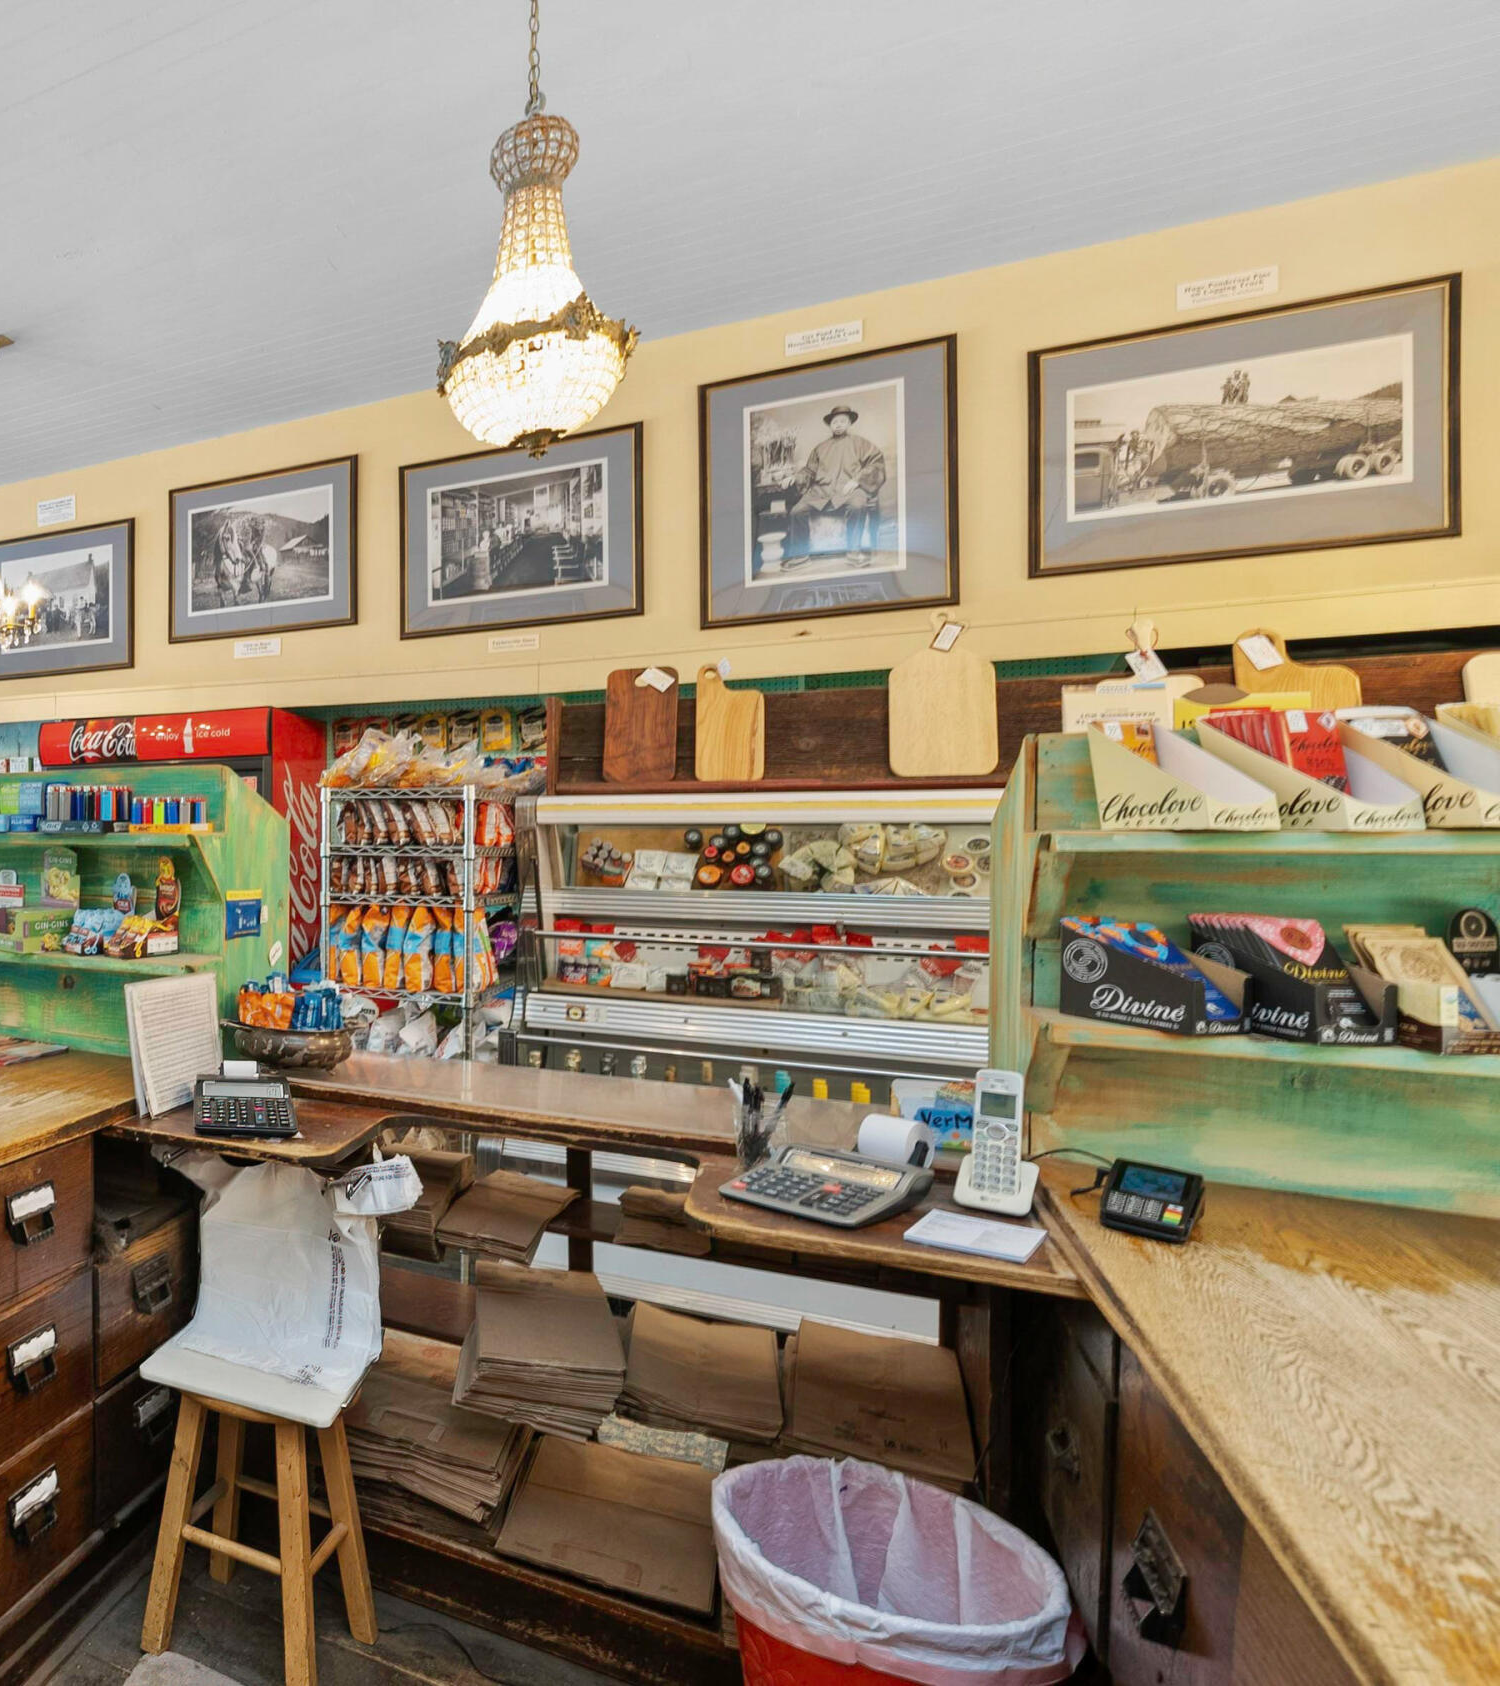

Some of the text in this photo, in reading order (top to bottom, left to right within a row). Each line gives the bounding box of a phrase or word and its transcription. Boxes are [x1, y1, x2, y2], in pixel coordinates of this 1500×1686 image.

[69, 721, 137, 762] Coca-Cola
[155, 731, 180, 742] enjoy
[210, 727, 231, 738] cold
[1102, 787, 1203, 823] Chocolove
[1213, 807, 1278, 826] Chocolove
[1354, 807, 1422, 827] Chocolove
[1284, 961, 1349, 981] Divine
[1090, 983, 1187, 1022] Divine
